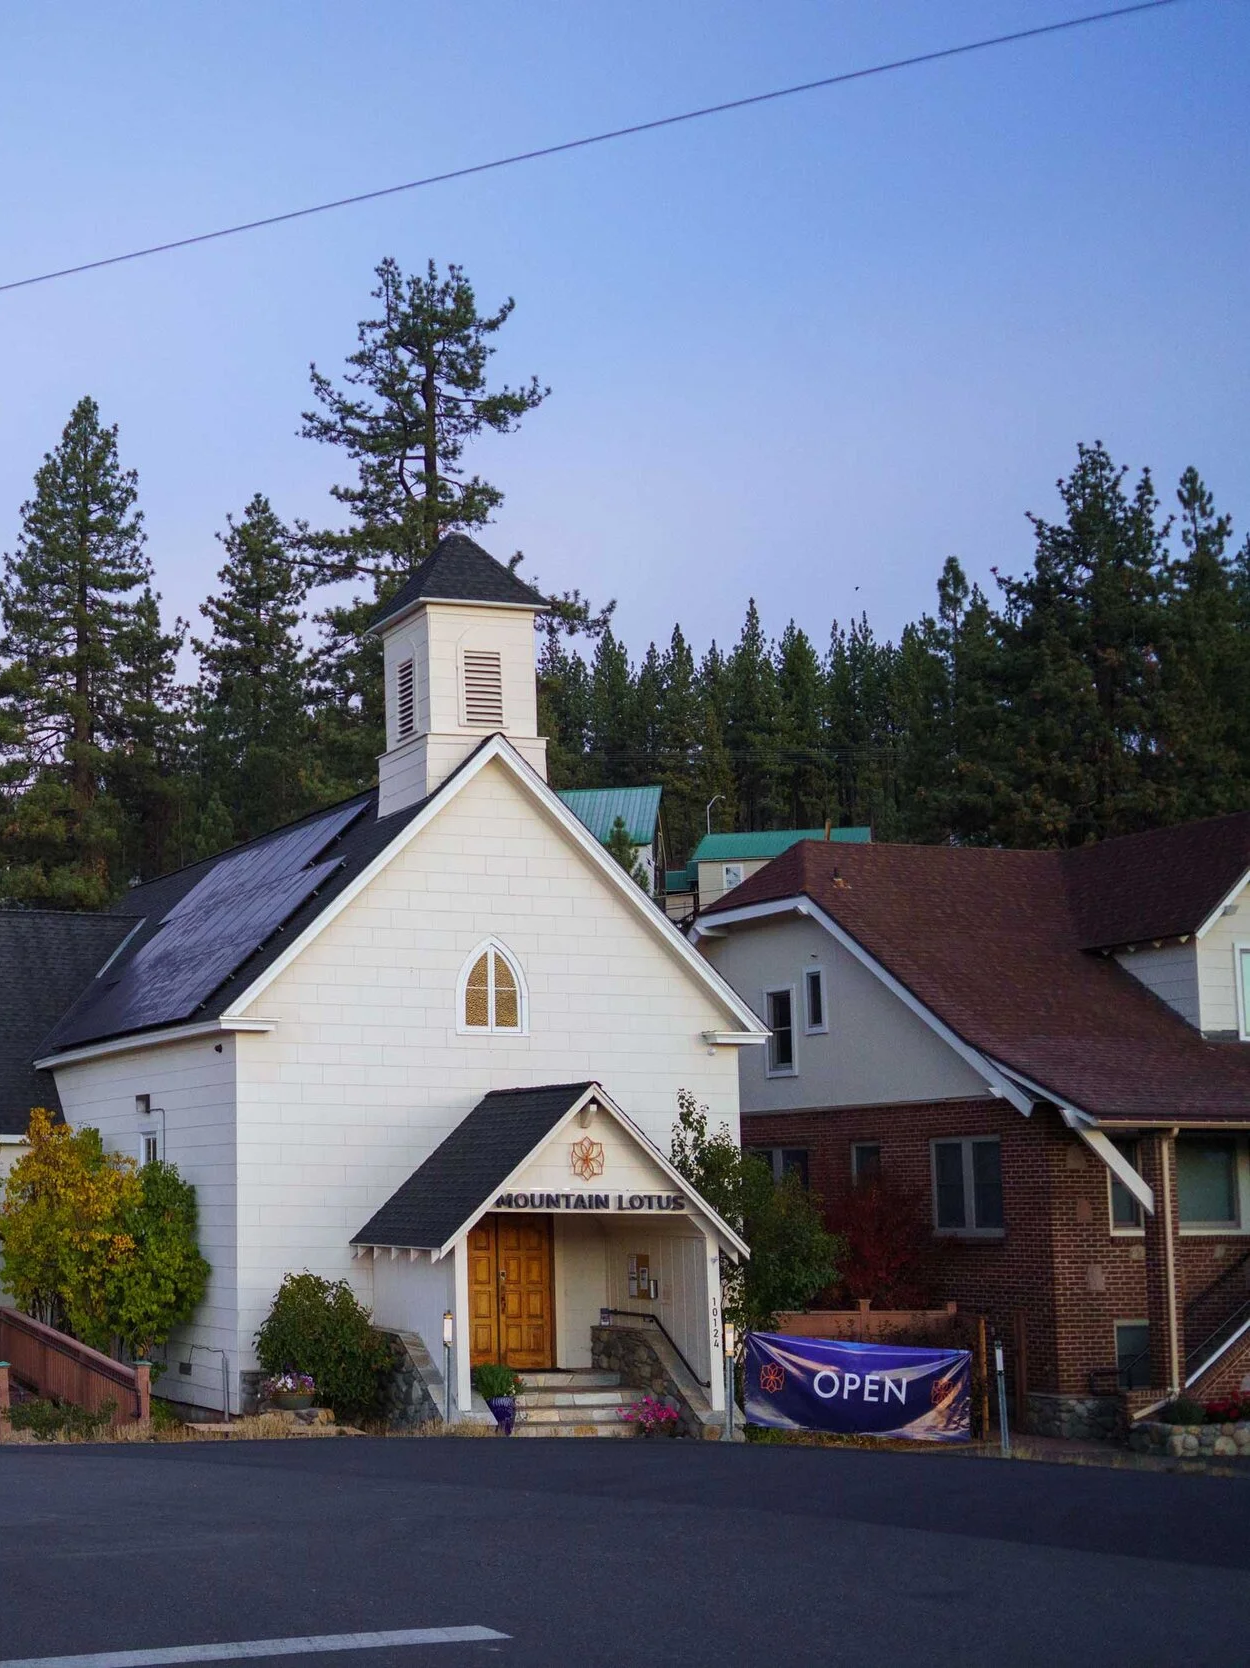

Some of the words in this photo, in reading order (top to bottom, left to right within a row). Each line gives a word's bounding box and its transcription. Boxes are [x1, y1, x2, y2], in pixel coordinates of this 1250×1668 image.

[496, 1193, 610, 1210] MOUNTAIN
[617, 1194, 686, 1211] LOTUS
[813, 1370, 907, 1406] OPEN
